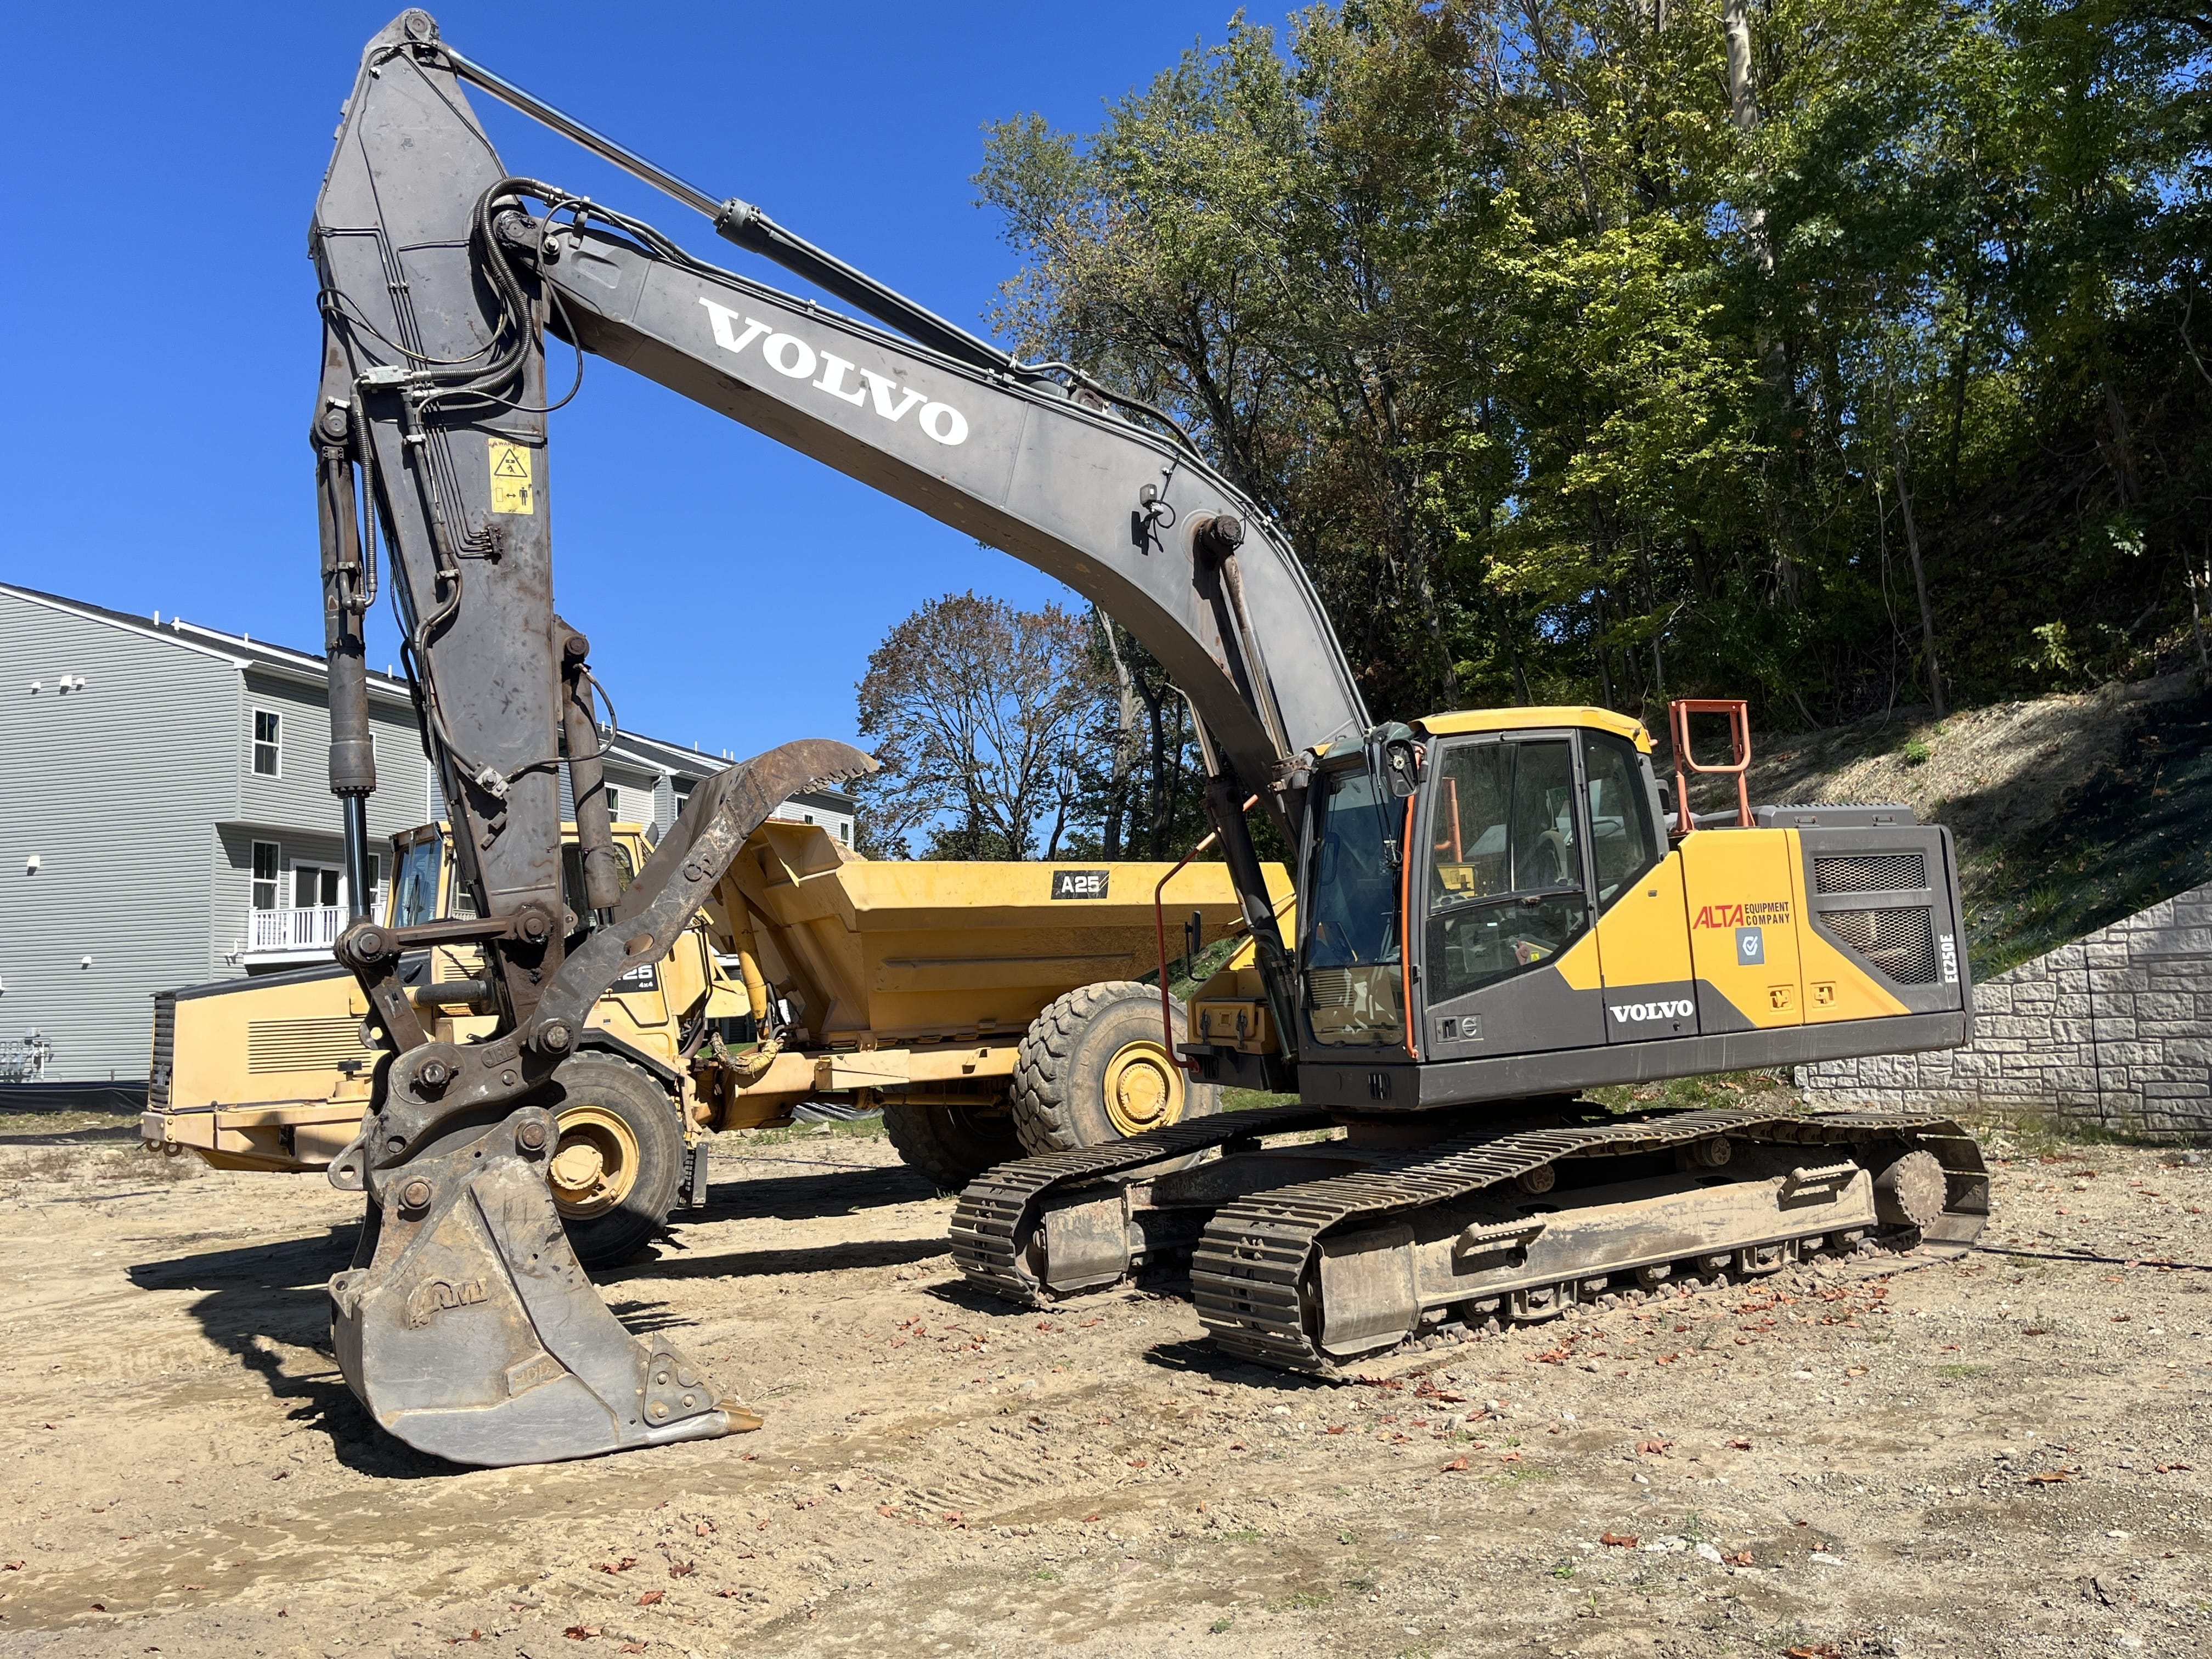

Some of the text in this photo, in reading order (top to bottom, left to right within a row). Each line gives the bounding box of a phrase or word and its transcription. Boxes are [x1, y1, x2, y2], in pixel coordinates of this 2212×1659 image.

[698, 296, 969, 445] VOLVO
[1061, 876, 1099, 893] A25
[1692, 904, 1744, 929] ALTA
[1745, 901, 1789, 914] EQUIPMENT
[1746, 913, 1790, 926] COMPANY
[1939, 934, 1959, 983] EC250E
[618, 964, 653, 981] 25
[1610, 999, 1694, 1023] VOLVO
[486, 1041, 516, 1065] JRB
